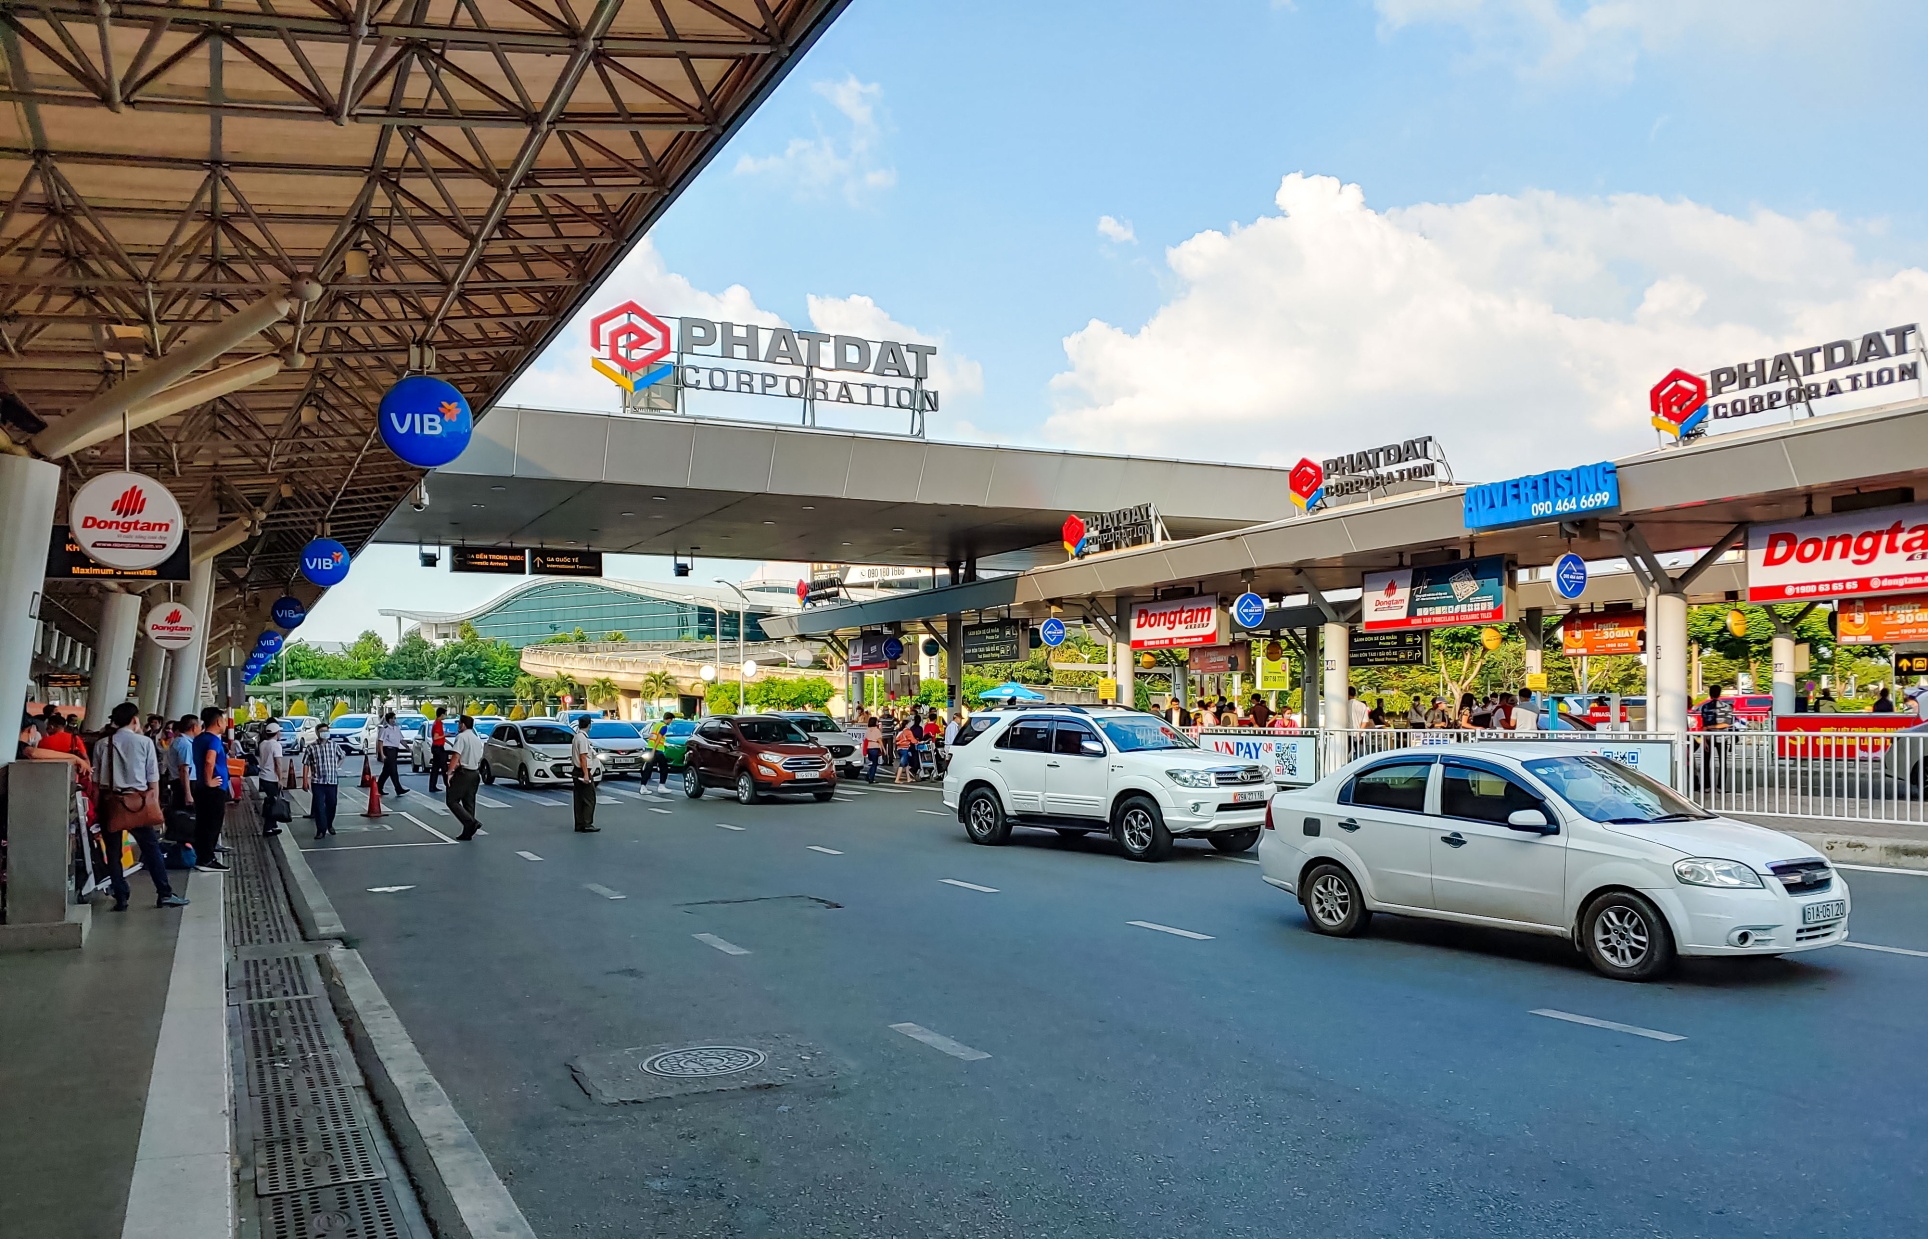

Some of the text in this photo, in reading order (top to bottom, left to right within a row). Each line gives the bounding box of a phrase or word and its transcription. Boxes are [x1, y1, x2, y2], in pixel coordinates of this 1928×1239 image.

[680, 316, 937, 380] PHATDAT
[1710, 323, 1917, 397] PHATDAT
[682, 364, 939, 412] CORPORATION
[1713, 362, 1919, 420] CORPORATION
[390, 412, 443, 435] VIB
[1322, 436, 1432, 479] PHATDAT
[1324, 463, 1435, 497] CORPORATION
[1465, 461, 1617, 511] ADVERTISING
[1531, 492, 1610, 516] 090 464 6699
[82, 516, 170, 533] Dongtam
[1084, 503, 1149, 533] PHATDAT
[72, 566, 114, 575] Maximum
[305, 558, 334, 570] VIB
[1818, 584, 1830, 592] 63
[1832, 582, 1844, 590] 65
[1846, 581, 1858, 589] 65
[276, 610, 295, 618] VIB
[1375, 598, 1404, 608] Dongtam
[151, 624, 192, 632] Dongtam
[1136, 605, 1212, 630] Dongtam
[1897, 614, 1914, 624] 30
[1603, 630, 1615, 639] 30
[1214, 741, 1273, 760] VNPAY QR
